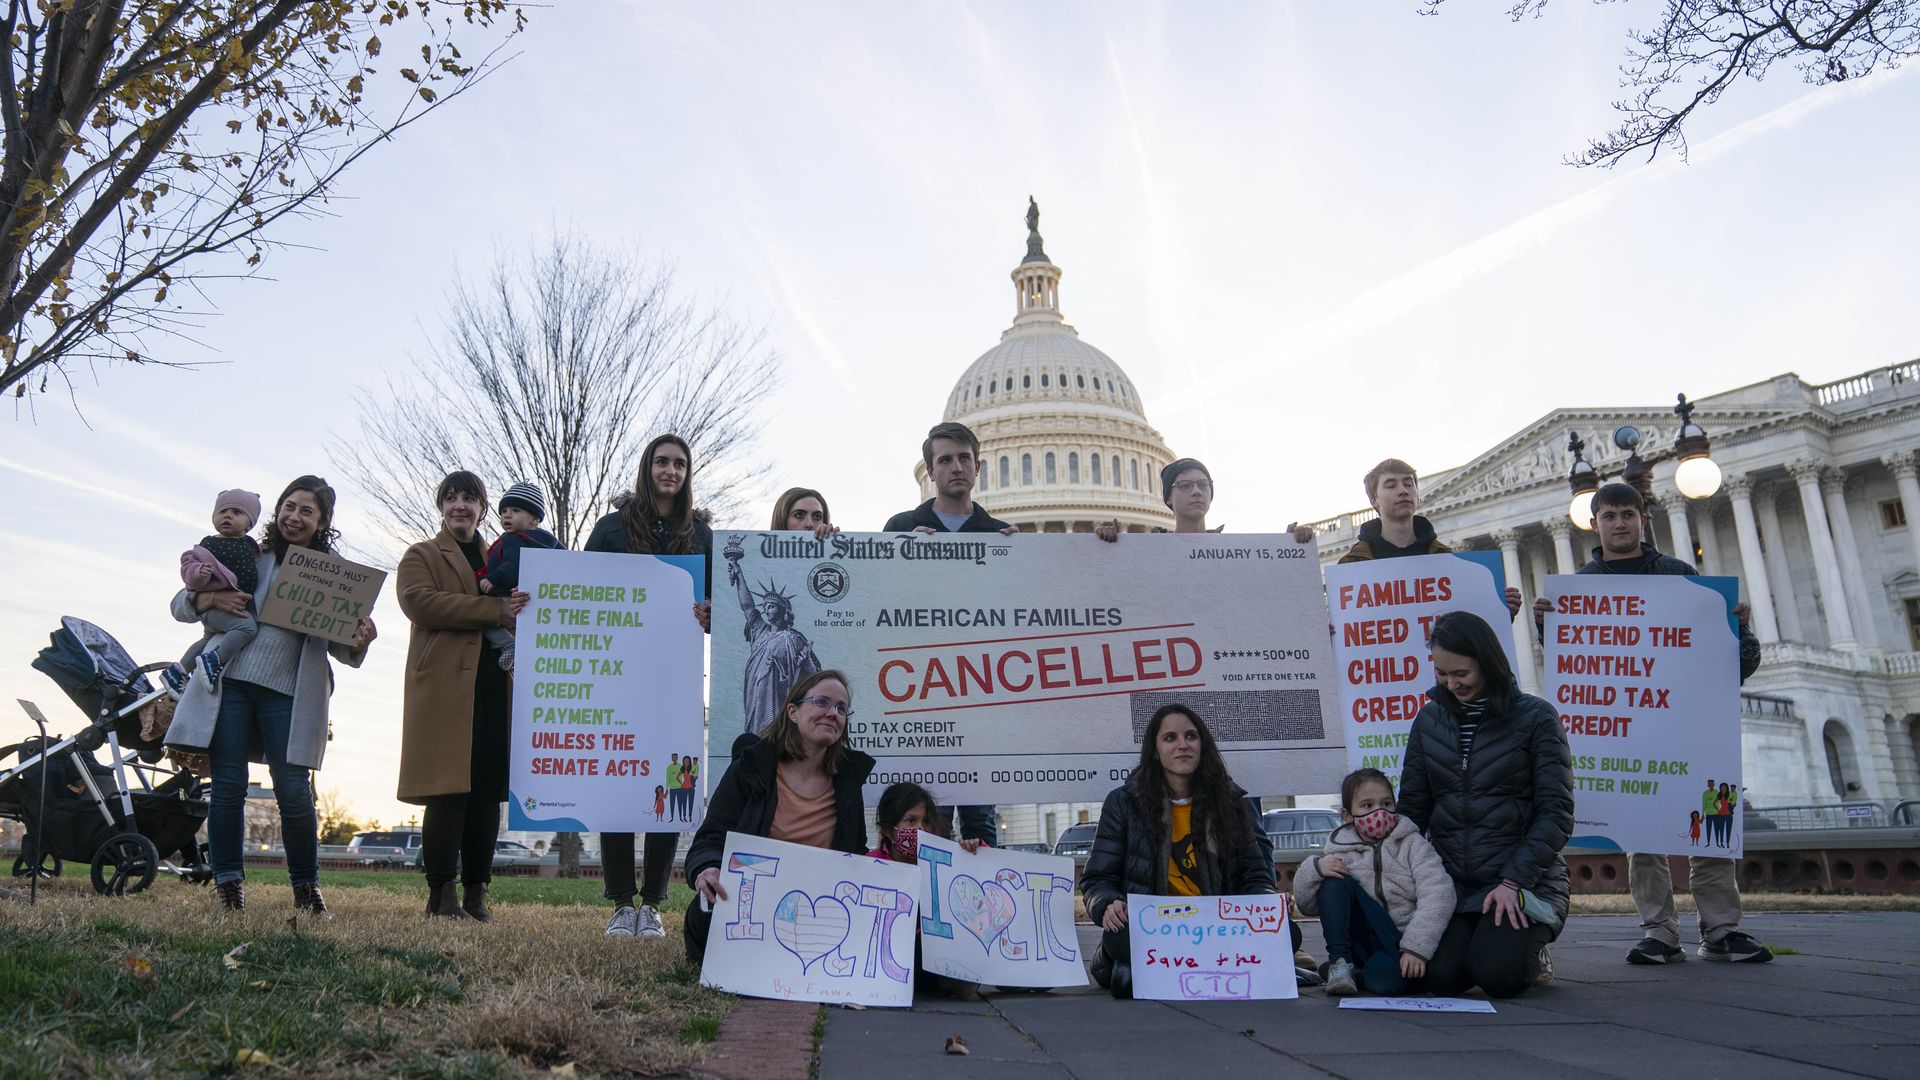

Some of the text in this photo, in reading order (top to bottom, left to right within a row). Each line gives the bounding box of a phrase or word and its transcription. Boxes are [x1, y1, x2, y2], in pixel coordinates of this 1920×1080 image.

[757, 533, 986, 565] United States Treasury
[1189, 548, 1306, 560] JANUARY 15, 2022
[288, 552, 369, 583] CONGRESS MUST
[298, 571, 353, 594] CONTINUE THE
[276, 581, 363, 618] CHILD TAX
[537, 583, 647, 604] DECEMBER 15
[1339, 576, 1452, 610] FAMILIES
[827, 609, 854, 618] Pay to
[1556, 595, 1646, 616] SENATE:
[536, 607, 643, 628] IS THE FINAL
[814, 618, 866, 627] the order of
[876, 607, 1122, 627] AMERICAN FAMILIES
[535, 633, 613, 651] MONTHLY
[1343, 618, 1409, 648] NEED
[1556, 625, 1692, 648] EXTEND THE
[534, 657, 623, 676] CHILD TAX
[878, 637, 1203, 702] CANCELLED
[1348, 655, 1419, 686] CHILD
[1557, 654, 1655, 678] MONTHLY
[1222, 673, 1243, 681] VOID
[1245, 673, 1272, 681] AFTER
[1294, 672, 1316, 680] YEAR
[533, 682, 594, 700] CREDIT
[1557, 684, 1670, 709] CHILD TAX
[532, 707, 628, 726] PAYMENT...
[1352, 693, 1432, 723] CREDI
[871, 722, 899, 734] TAX
[903, 721, 956, 734] CREDIT
[1558, 714, 1632, 738] CREDIT
[531, 732, 635, 750] UNLESS THE
[848, 735, 964, 749] NTHLY PAYMENT
[531, 757, 650, 776] SENATE ACTS
[1362, 755, 1399, 769] AWAY
[1571, 755, 1689, 776] ASS BUILD BACK
[1620, 779, 1659, 795] NOW!
[726, 852, 780, 941] I
[918, 844, 953, 939] I
[1223, 901, 1277, 915] Do your
[1258, 914, 1276, 928] job
[1146, 949, 1199, 968] Save
[1185, 976, 1239, 995] CTC
